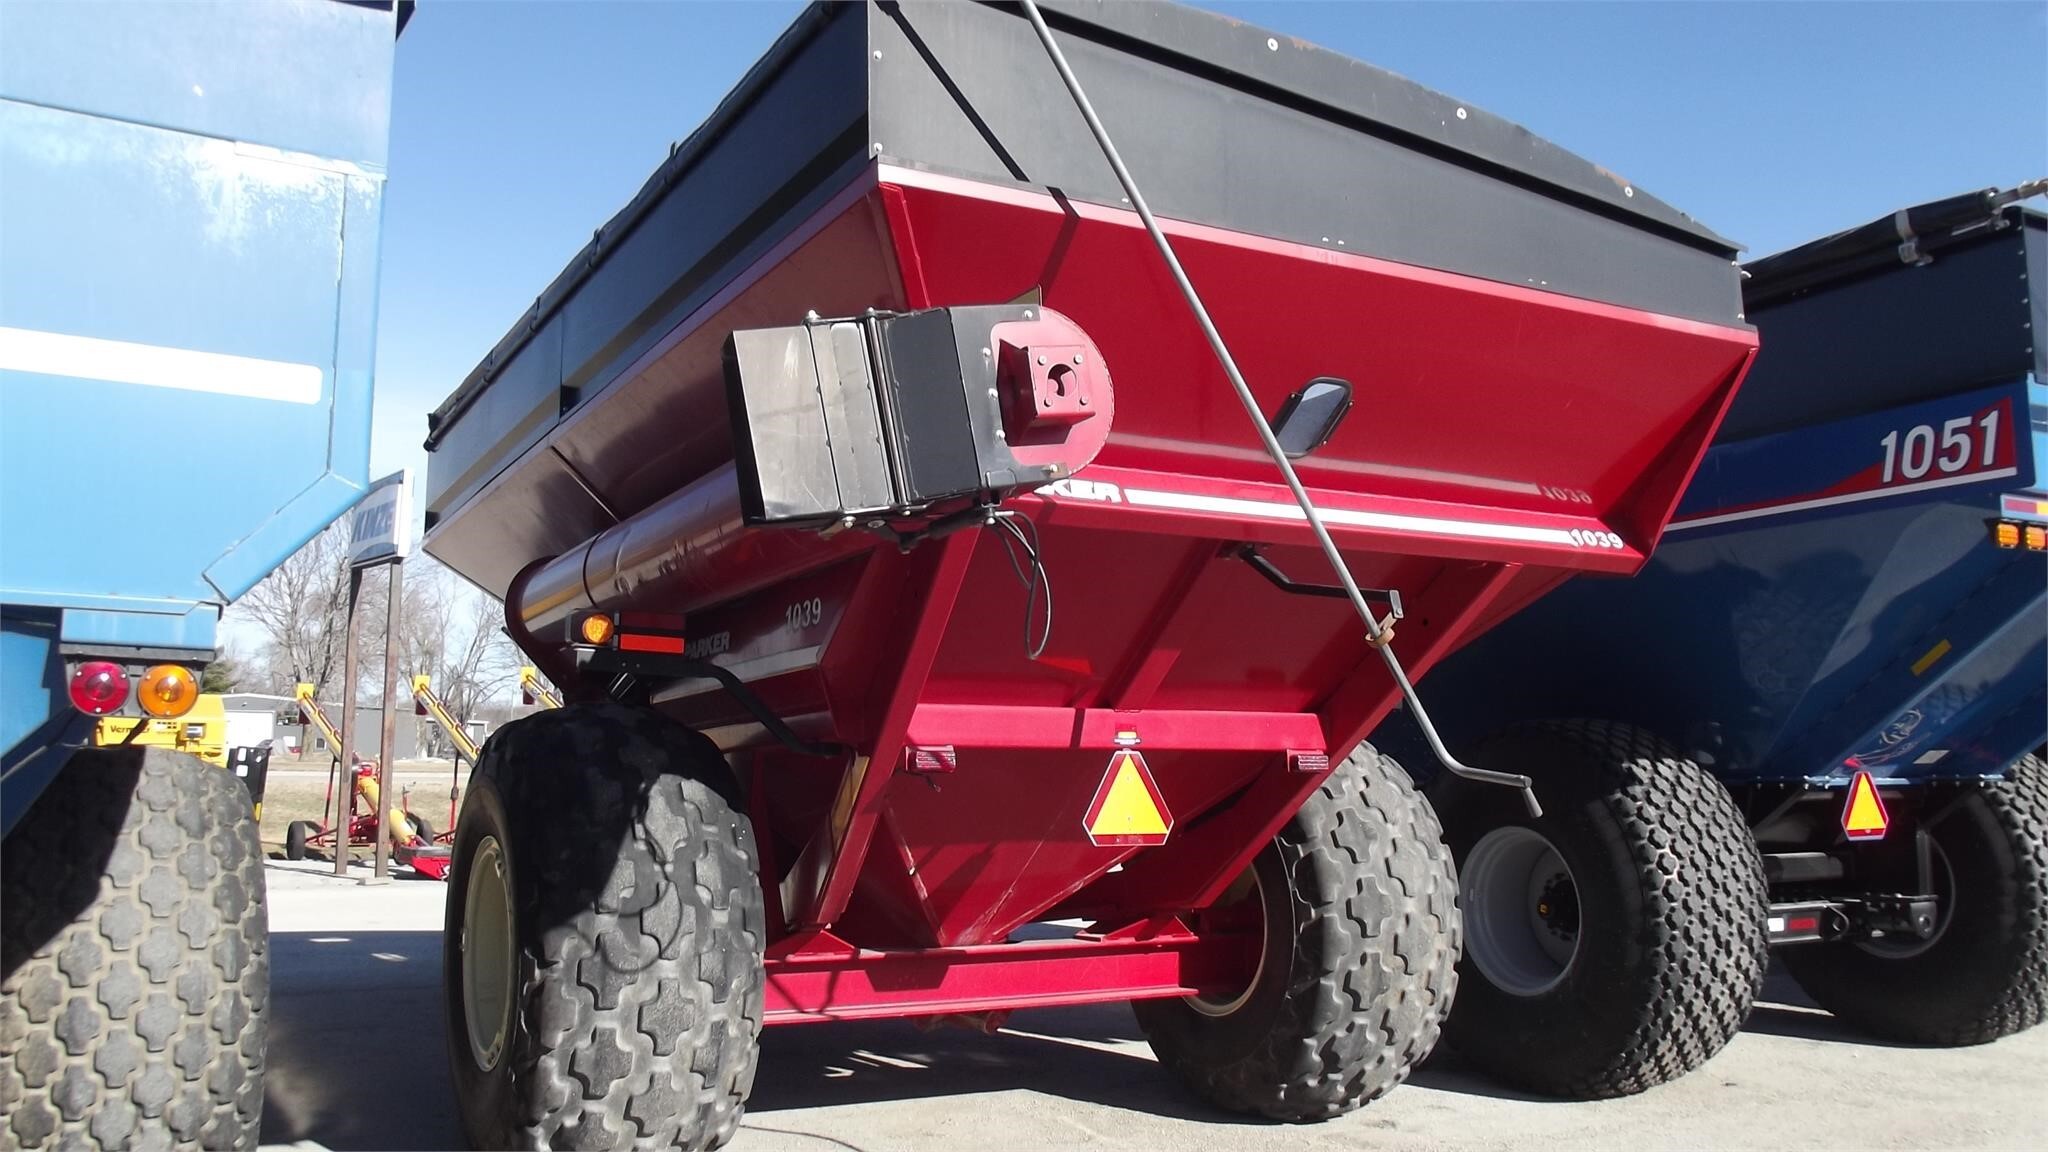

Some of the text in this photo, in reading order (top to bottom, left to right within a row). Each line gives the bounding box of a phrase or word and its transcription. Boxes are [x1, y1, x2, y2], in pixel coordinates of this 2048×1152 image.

[1880, 409, 1999, 483] 1051
[1034, 478, 1122, 504] KER
[1569, 528, 1624, 549] 1039
[786, 597, 822, 634] 1039
